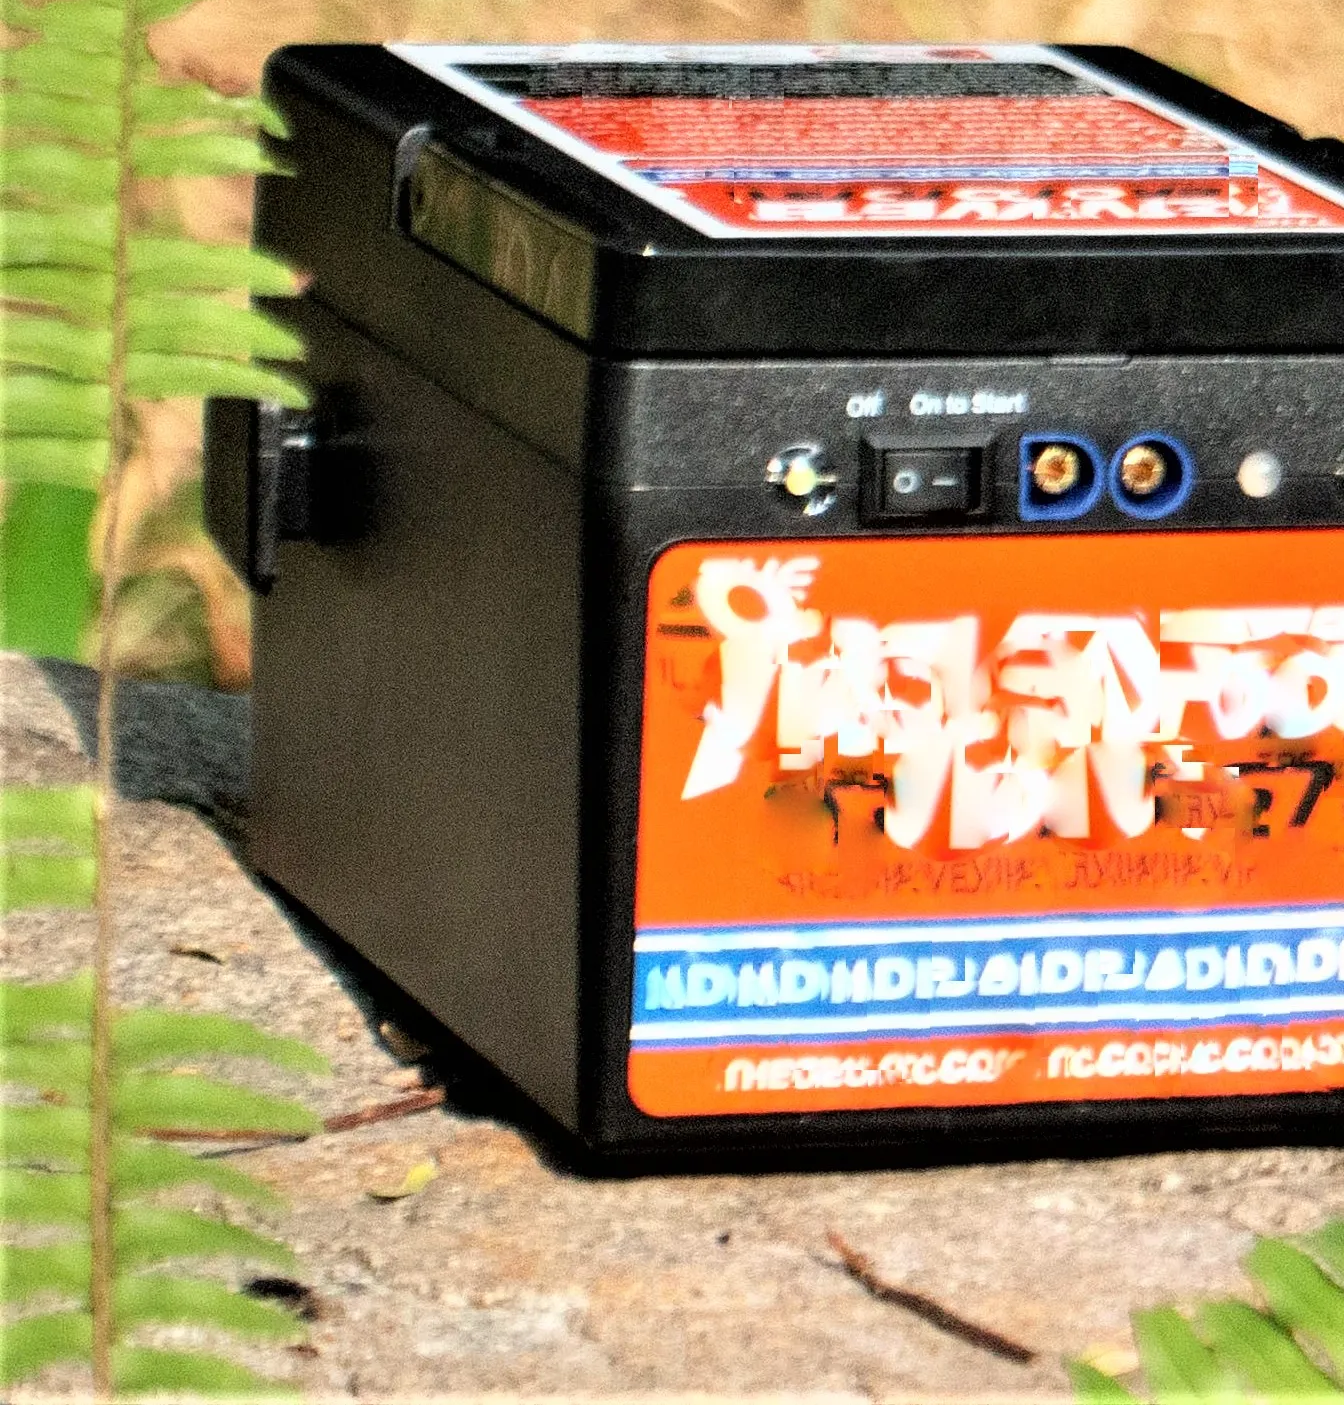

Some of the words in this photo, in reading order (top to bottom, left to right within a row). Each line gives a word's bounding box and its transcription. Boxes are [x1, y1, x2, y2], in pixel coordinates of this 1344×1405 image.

[846, 388, 884, 418] Off
[909, 391, 944, 416] On
[945, 392, 971, 416] to
